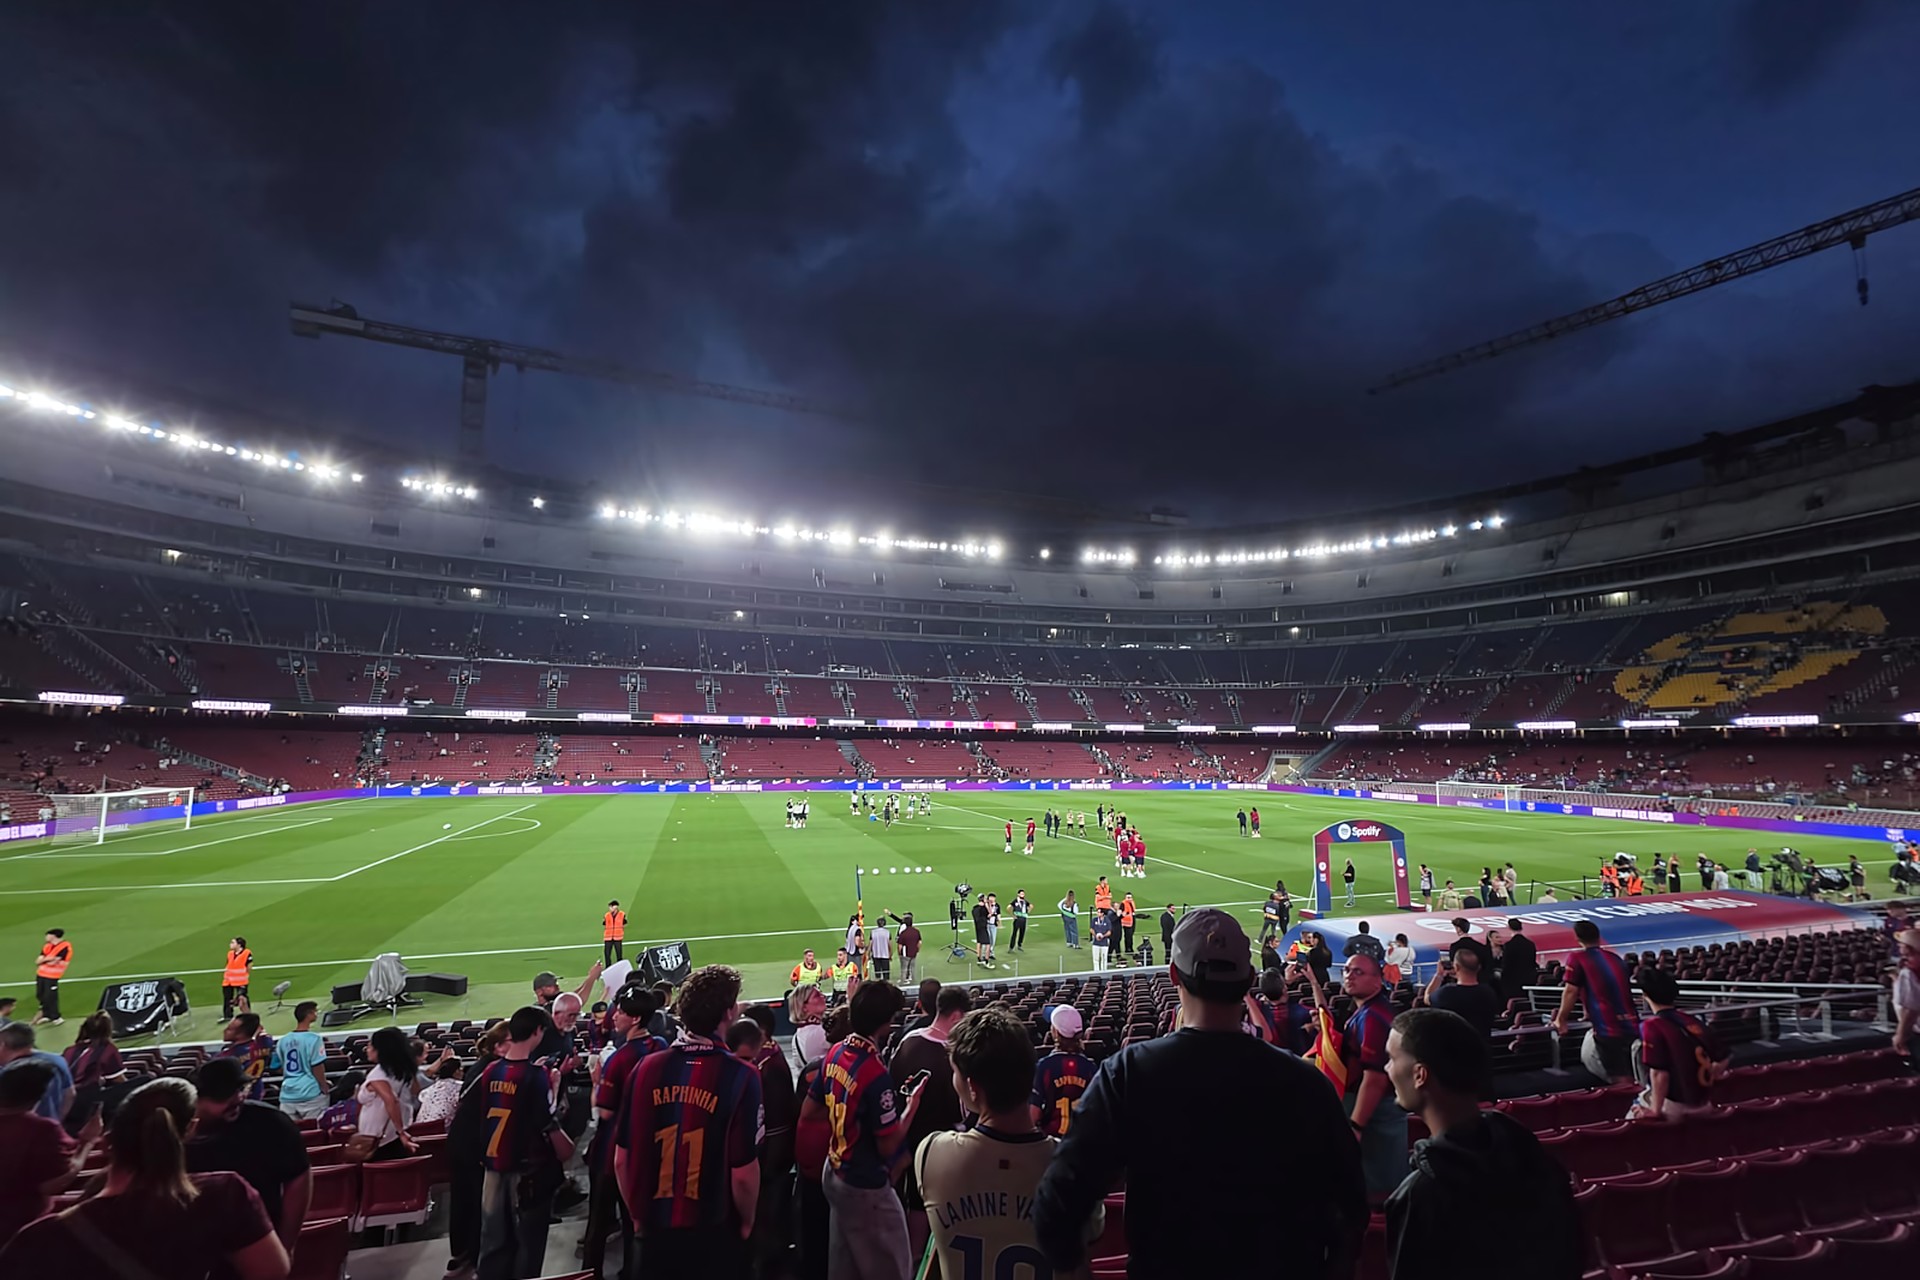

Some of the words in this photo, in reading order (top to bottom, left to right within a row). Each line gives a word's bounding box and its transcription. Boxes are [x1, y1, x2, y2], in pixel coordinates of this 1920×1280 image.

[1352, 825, 1381, 838] Spotify
[286, 1049, 301, 1072] 8
[653, 1086, 719, 1114] RAPHINHA
[486, 1106, 512, 1157] 7
[653, 1123, 705, 1201] 11
[935, 1192, 1008, 1229] LAMINE
